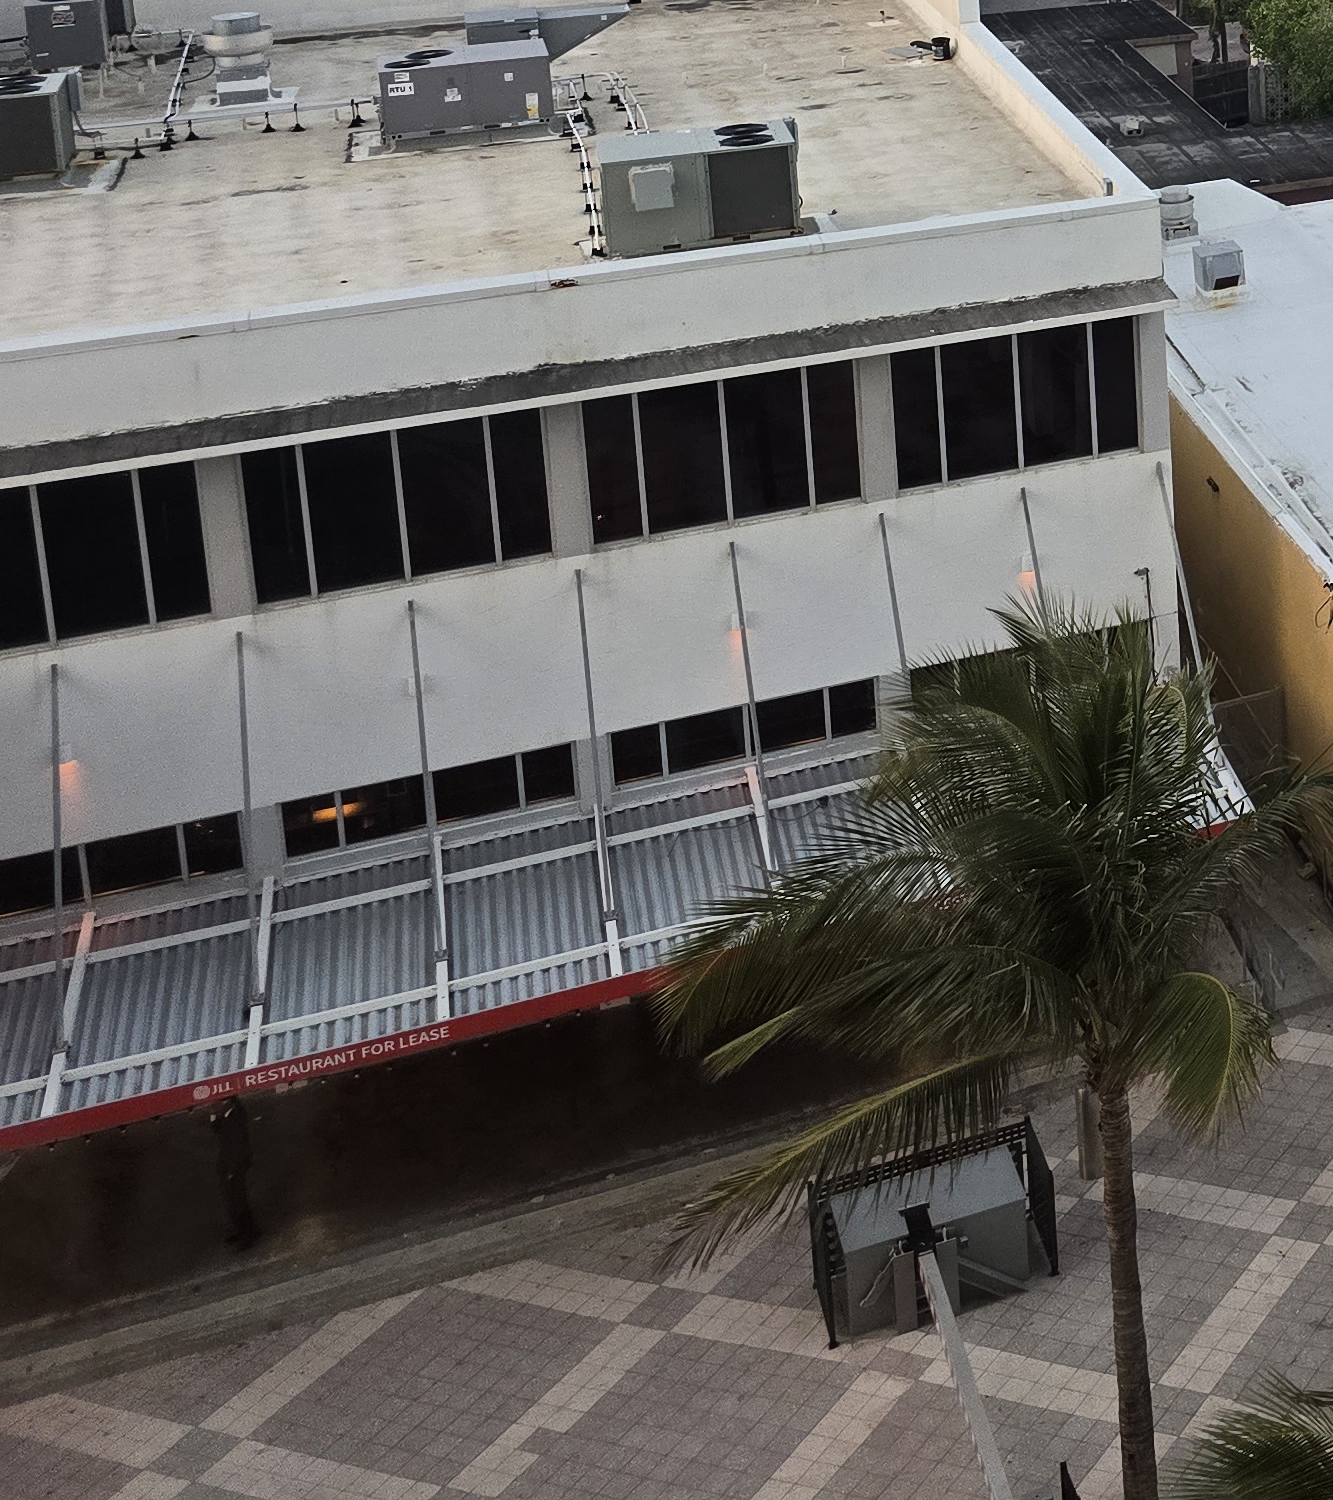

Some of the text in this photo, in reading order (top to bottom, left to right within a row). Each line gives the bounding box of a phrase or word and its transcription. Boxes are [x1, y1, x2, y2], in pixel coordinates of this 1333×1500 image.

[389, 86, 406, 94] RTU
[245, 1050, 356, 1087] RESTAURANT
[362, 1040, 395, 1059] FOR
[399, 1026, 451, 1049] LEASE
